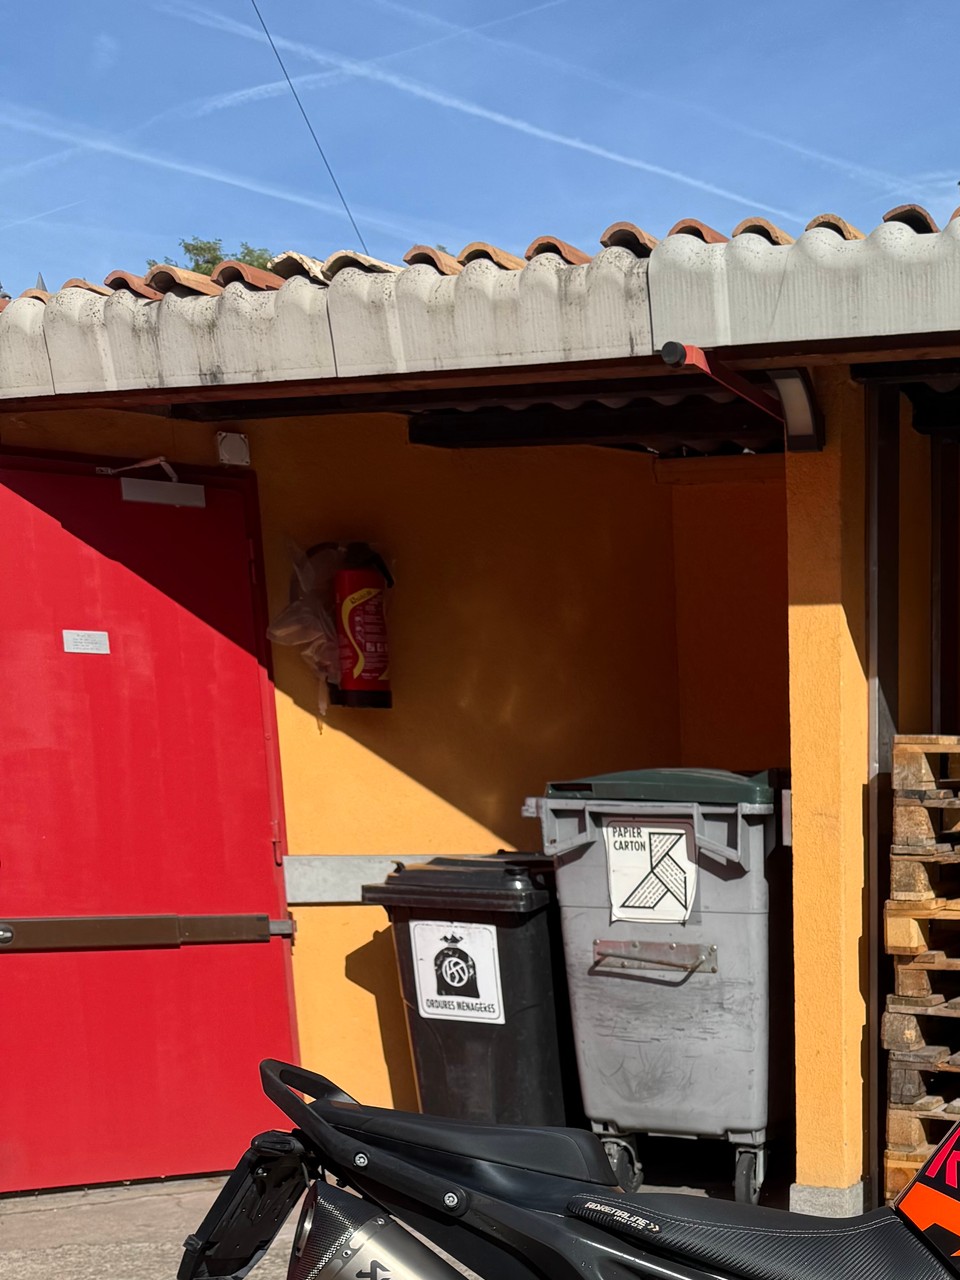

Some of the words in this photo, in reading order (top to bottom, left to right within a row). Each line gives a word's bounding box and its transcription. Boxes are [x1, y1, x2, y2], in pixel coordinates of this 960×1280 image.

[612, 827, 642, 838] PAPIER
[613, 841, 646, 852] CARTON
[426, 998, 455, 1010] ORDURES
